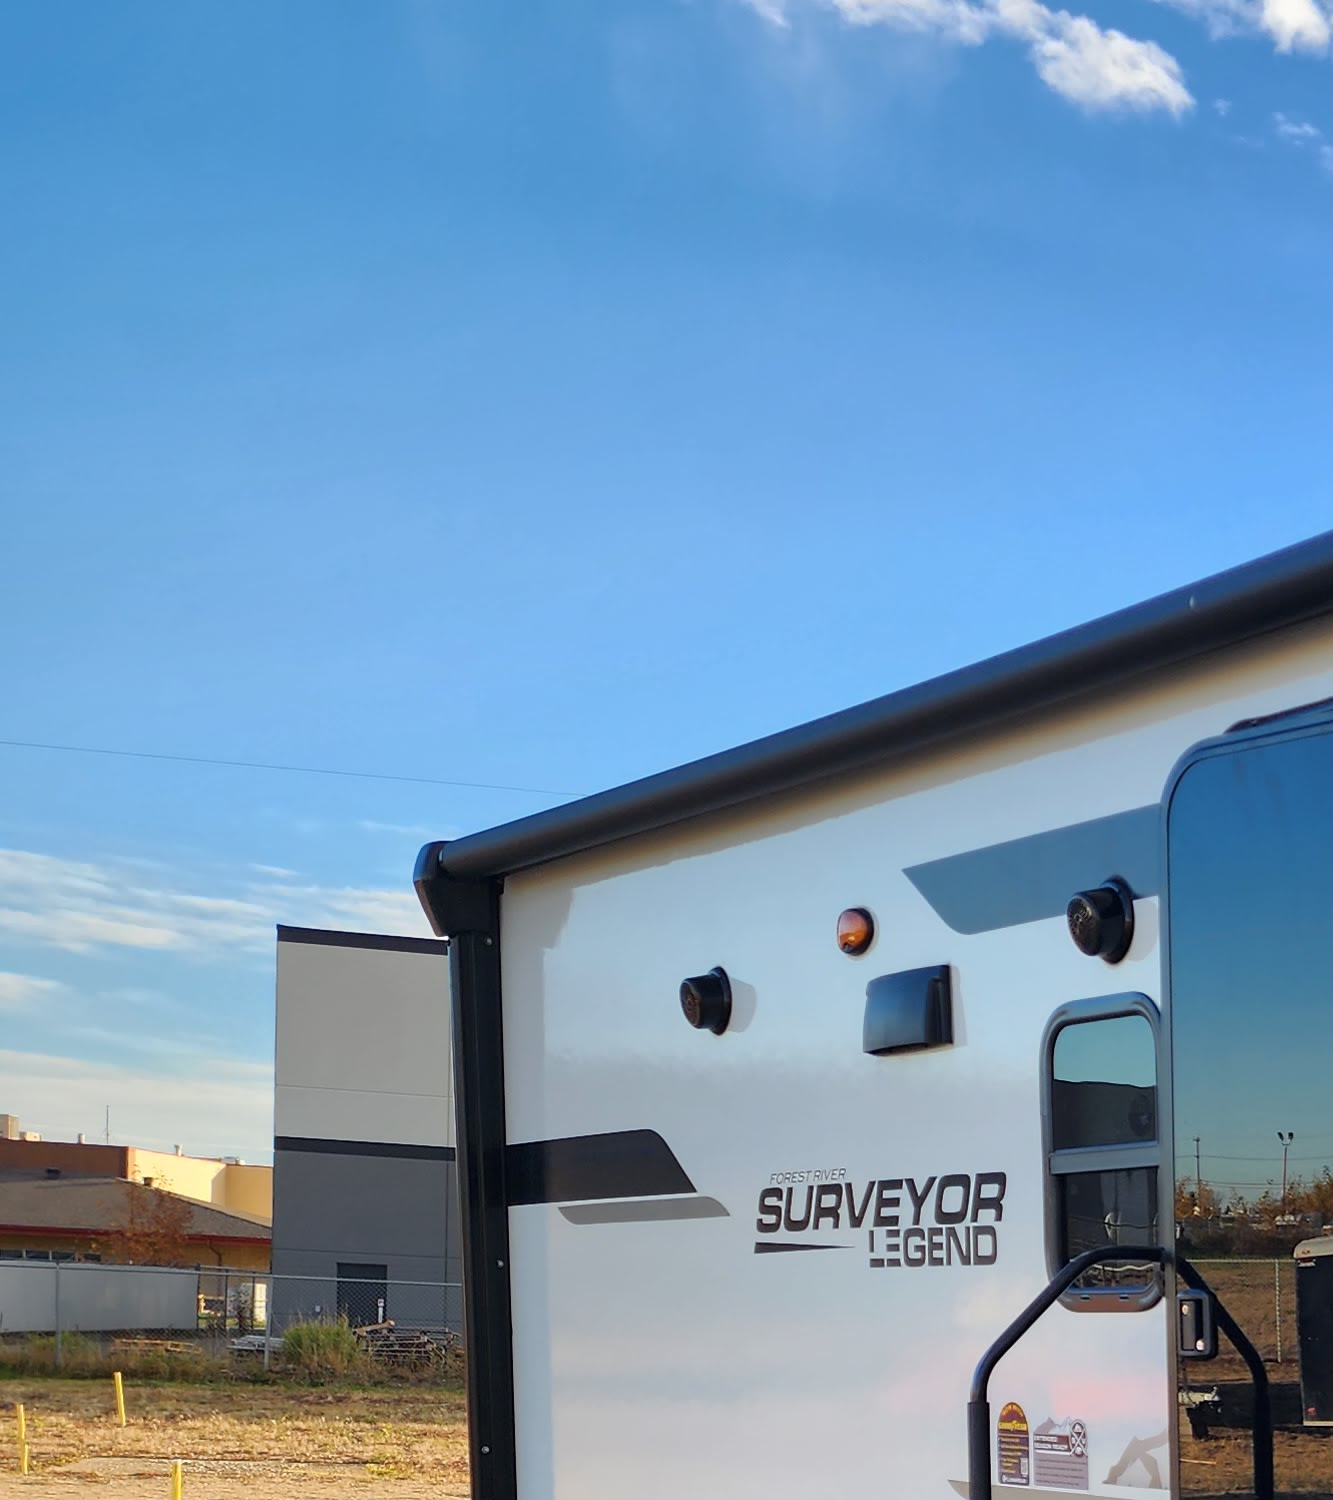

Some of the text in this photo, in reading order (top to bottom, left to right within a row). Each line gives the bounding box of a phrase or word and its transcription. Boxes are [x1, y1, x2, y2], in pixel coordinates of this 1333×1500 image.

[769, 1167, 847, 1185] FOREST RIVER
[755, 1171, 1007, 1233] SURVEYOR
[868, 1224, 998, 1268] LEGEND
